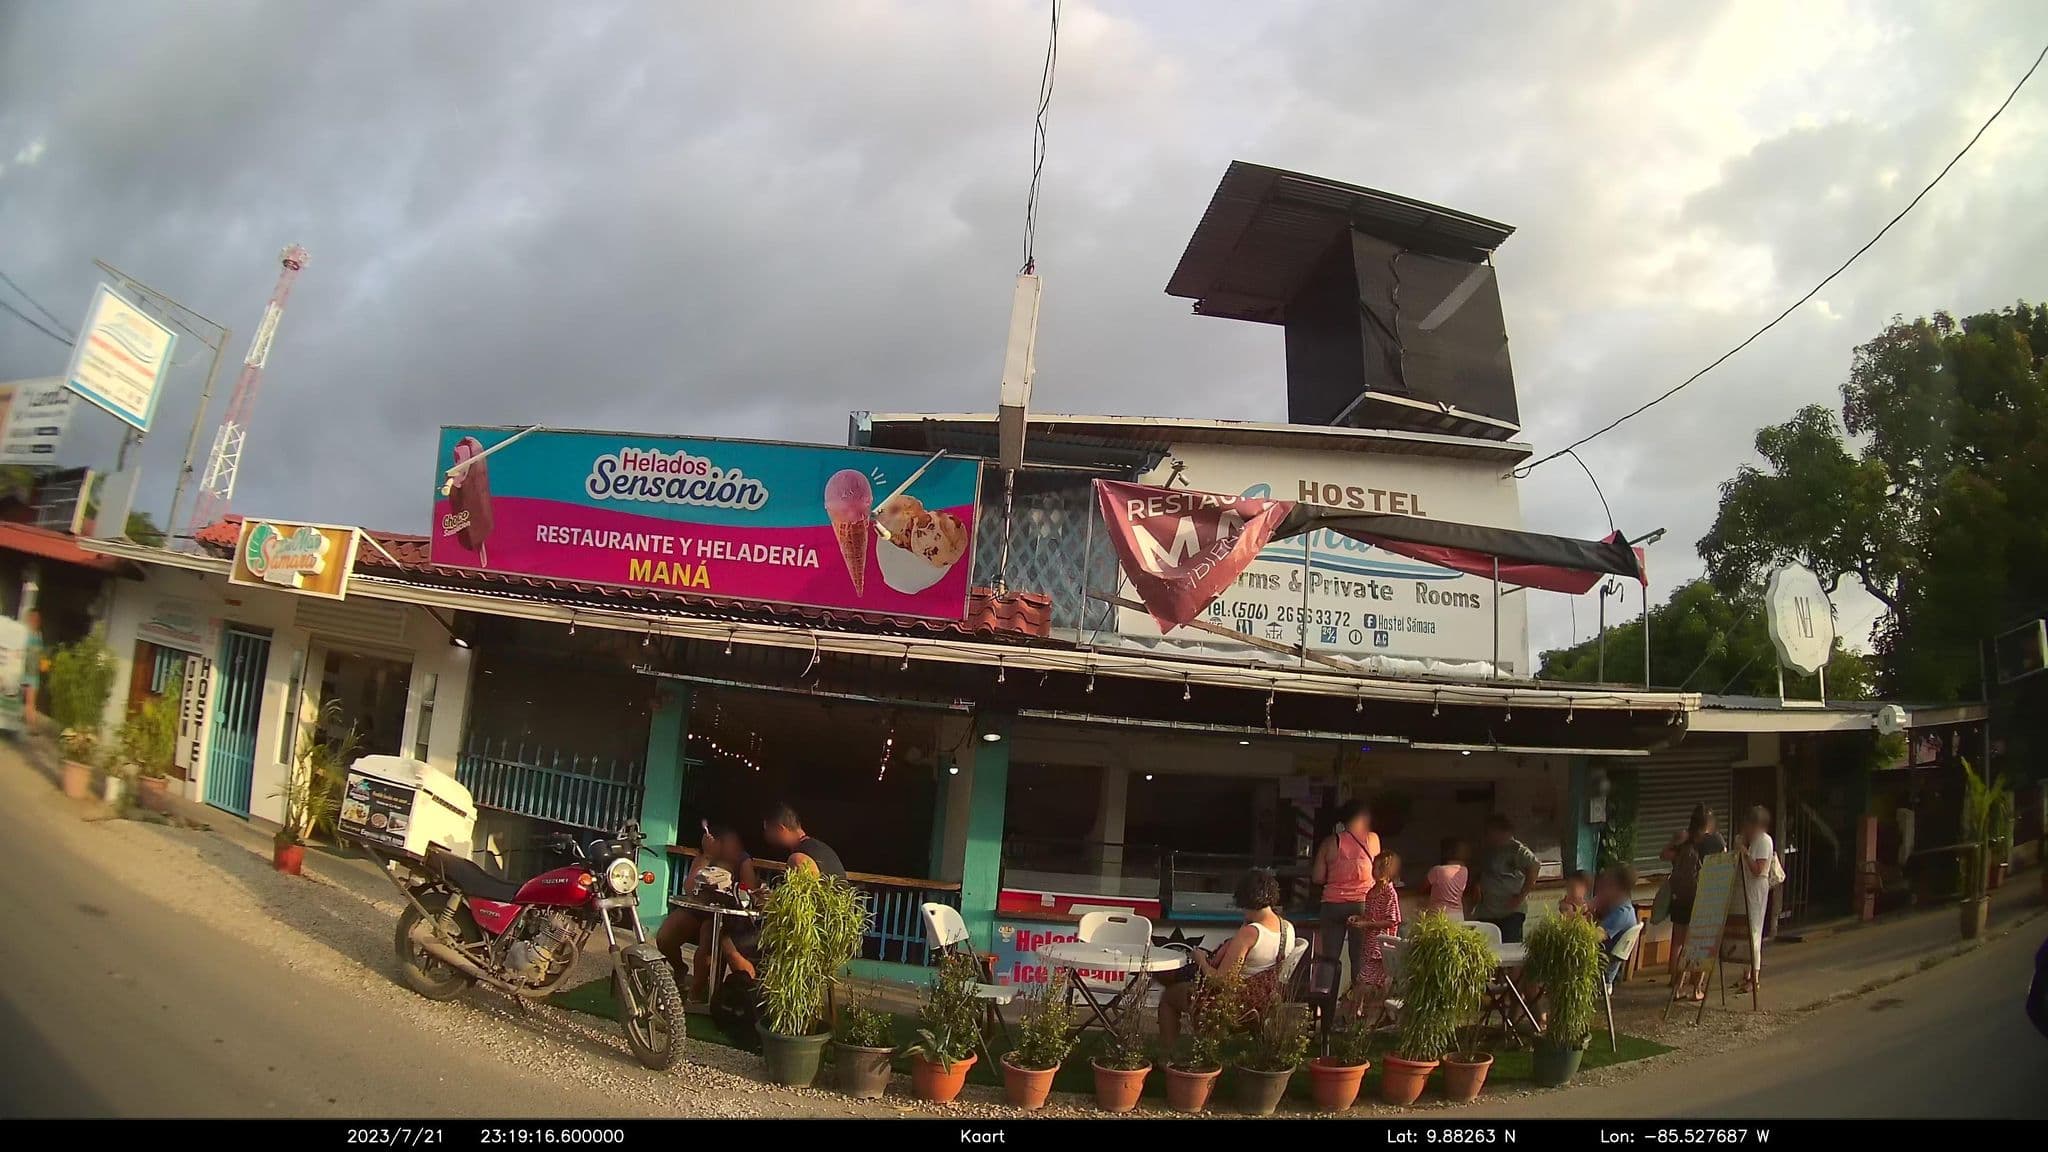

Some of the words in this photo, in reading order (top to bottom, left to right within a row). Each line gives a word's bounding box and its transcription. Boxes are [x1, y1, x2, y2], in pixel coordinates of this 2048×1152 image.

[589, 459, 764, 505] Sensación
[622, 452, 708, 476] Helados
[1298, 479, 1427, 517] HOSTEL
[536, 524, 675, 555] RESTAURANTE
[679, 537, 693, 556] Y
[696, 538, 820, 569] HELADERÍA
[628, 559, 711, 589] MANÁ
[1308, 571, 1394, 601] Private
[1415, 581, 1481, 609] Rooms
[1378, 614, 1405, 632] Hostel
[187, 656, 211, 783] HOSTEL
[1013, 961, 1048, 984] ice
